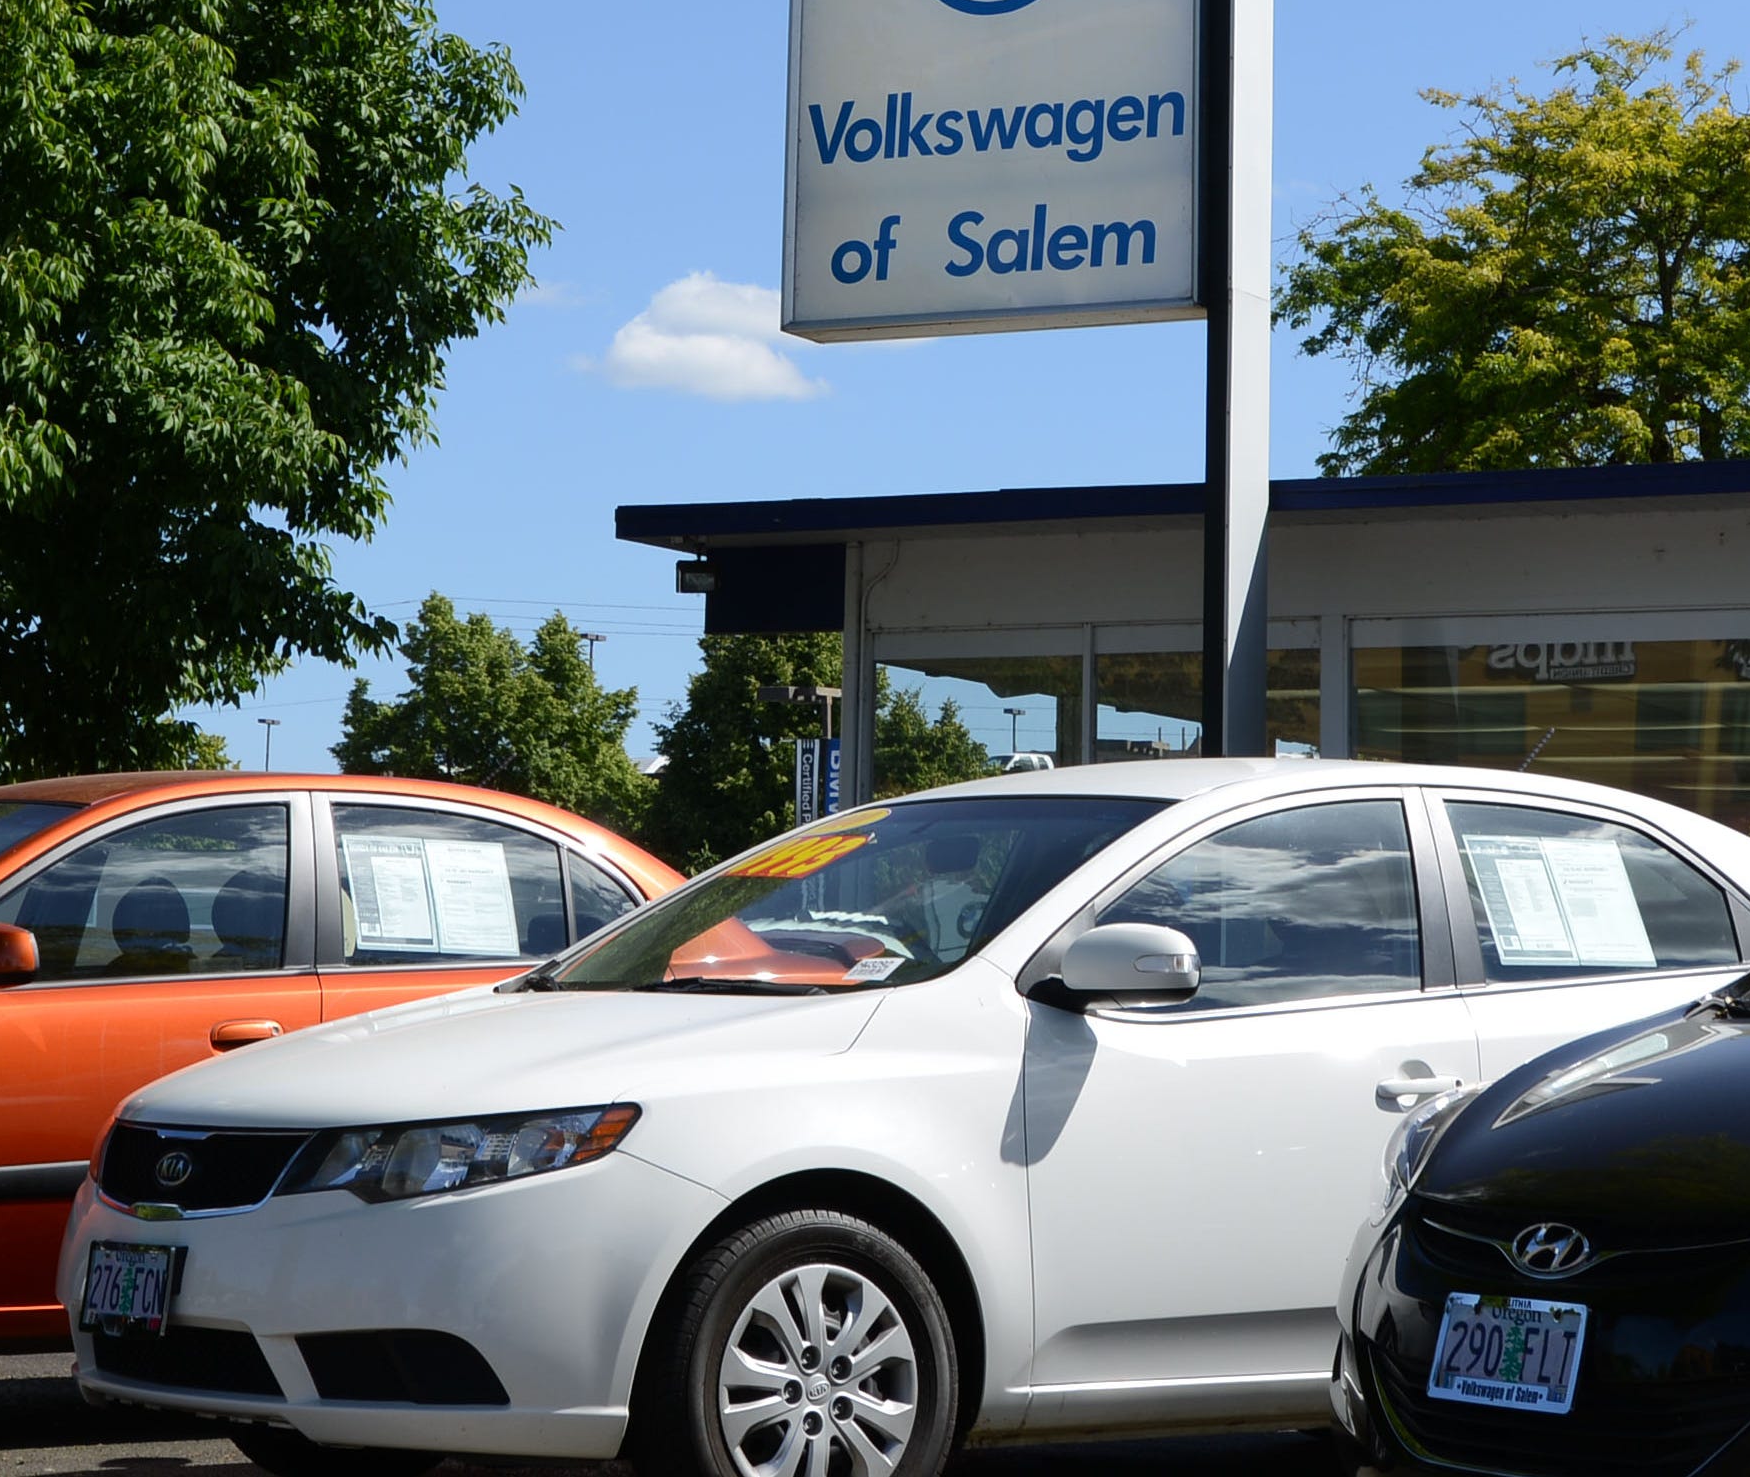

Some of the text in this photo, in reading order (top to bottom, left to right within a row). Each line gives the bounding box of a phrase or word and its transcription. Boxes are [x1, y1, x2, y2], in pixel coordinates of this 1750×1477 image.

[808, 90, 1185, 164] Volkswagen
[830, 203, 1157, 284] of Salem
[802, 753, 813, 811] Certified
[89, 1265, 167, 1315] 276 FCN
[1445, 1321, 1577, 1385] 290 FLT
[1461, 1380, 1539, 1404] Volkswagen of Salem
